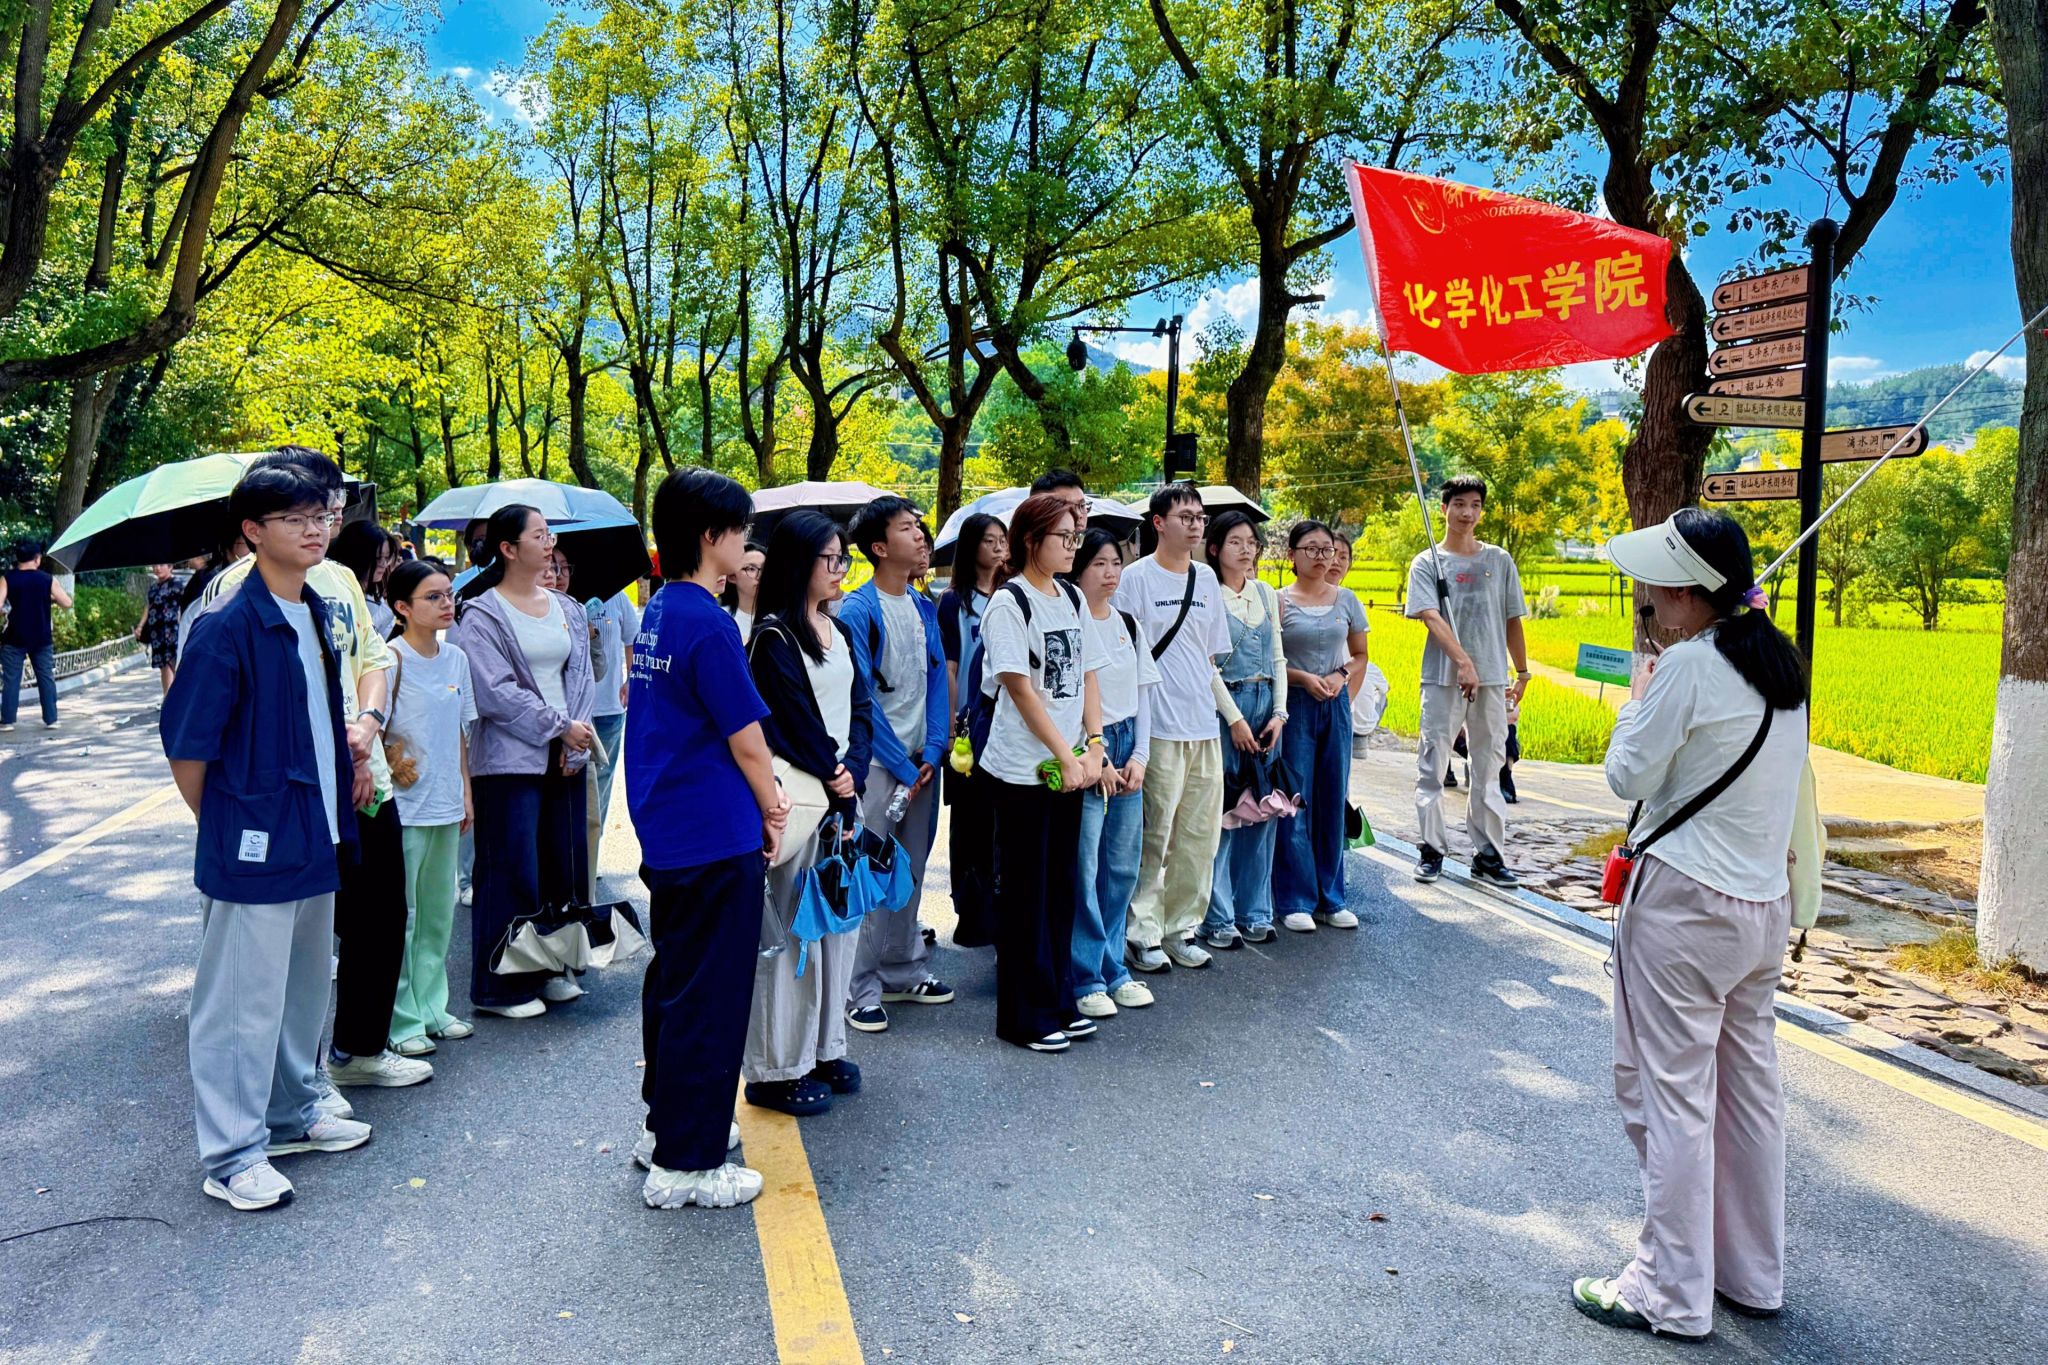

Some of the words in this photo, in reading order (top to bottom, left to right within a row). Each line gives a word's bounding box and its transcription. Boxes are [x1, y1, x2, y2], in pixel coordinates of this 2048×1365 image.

[1402, 249, 1649, 329] 化学化工学院
[1751, 273, 1800, 293] 毛泽东广场
[1745, 375, 1785, 392] 韶山宾馆
[1735, 400, 1803, 417] 韶山毛泽东同志故居
[1846, 435, 1879, 449] 滴水洞
[1740, 475, 1795, 489] 韶山毛泽东图书馆
